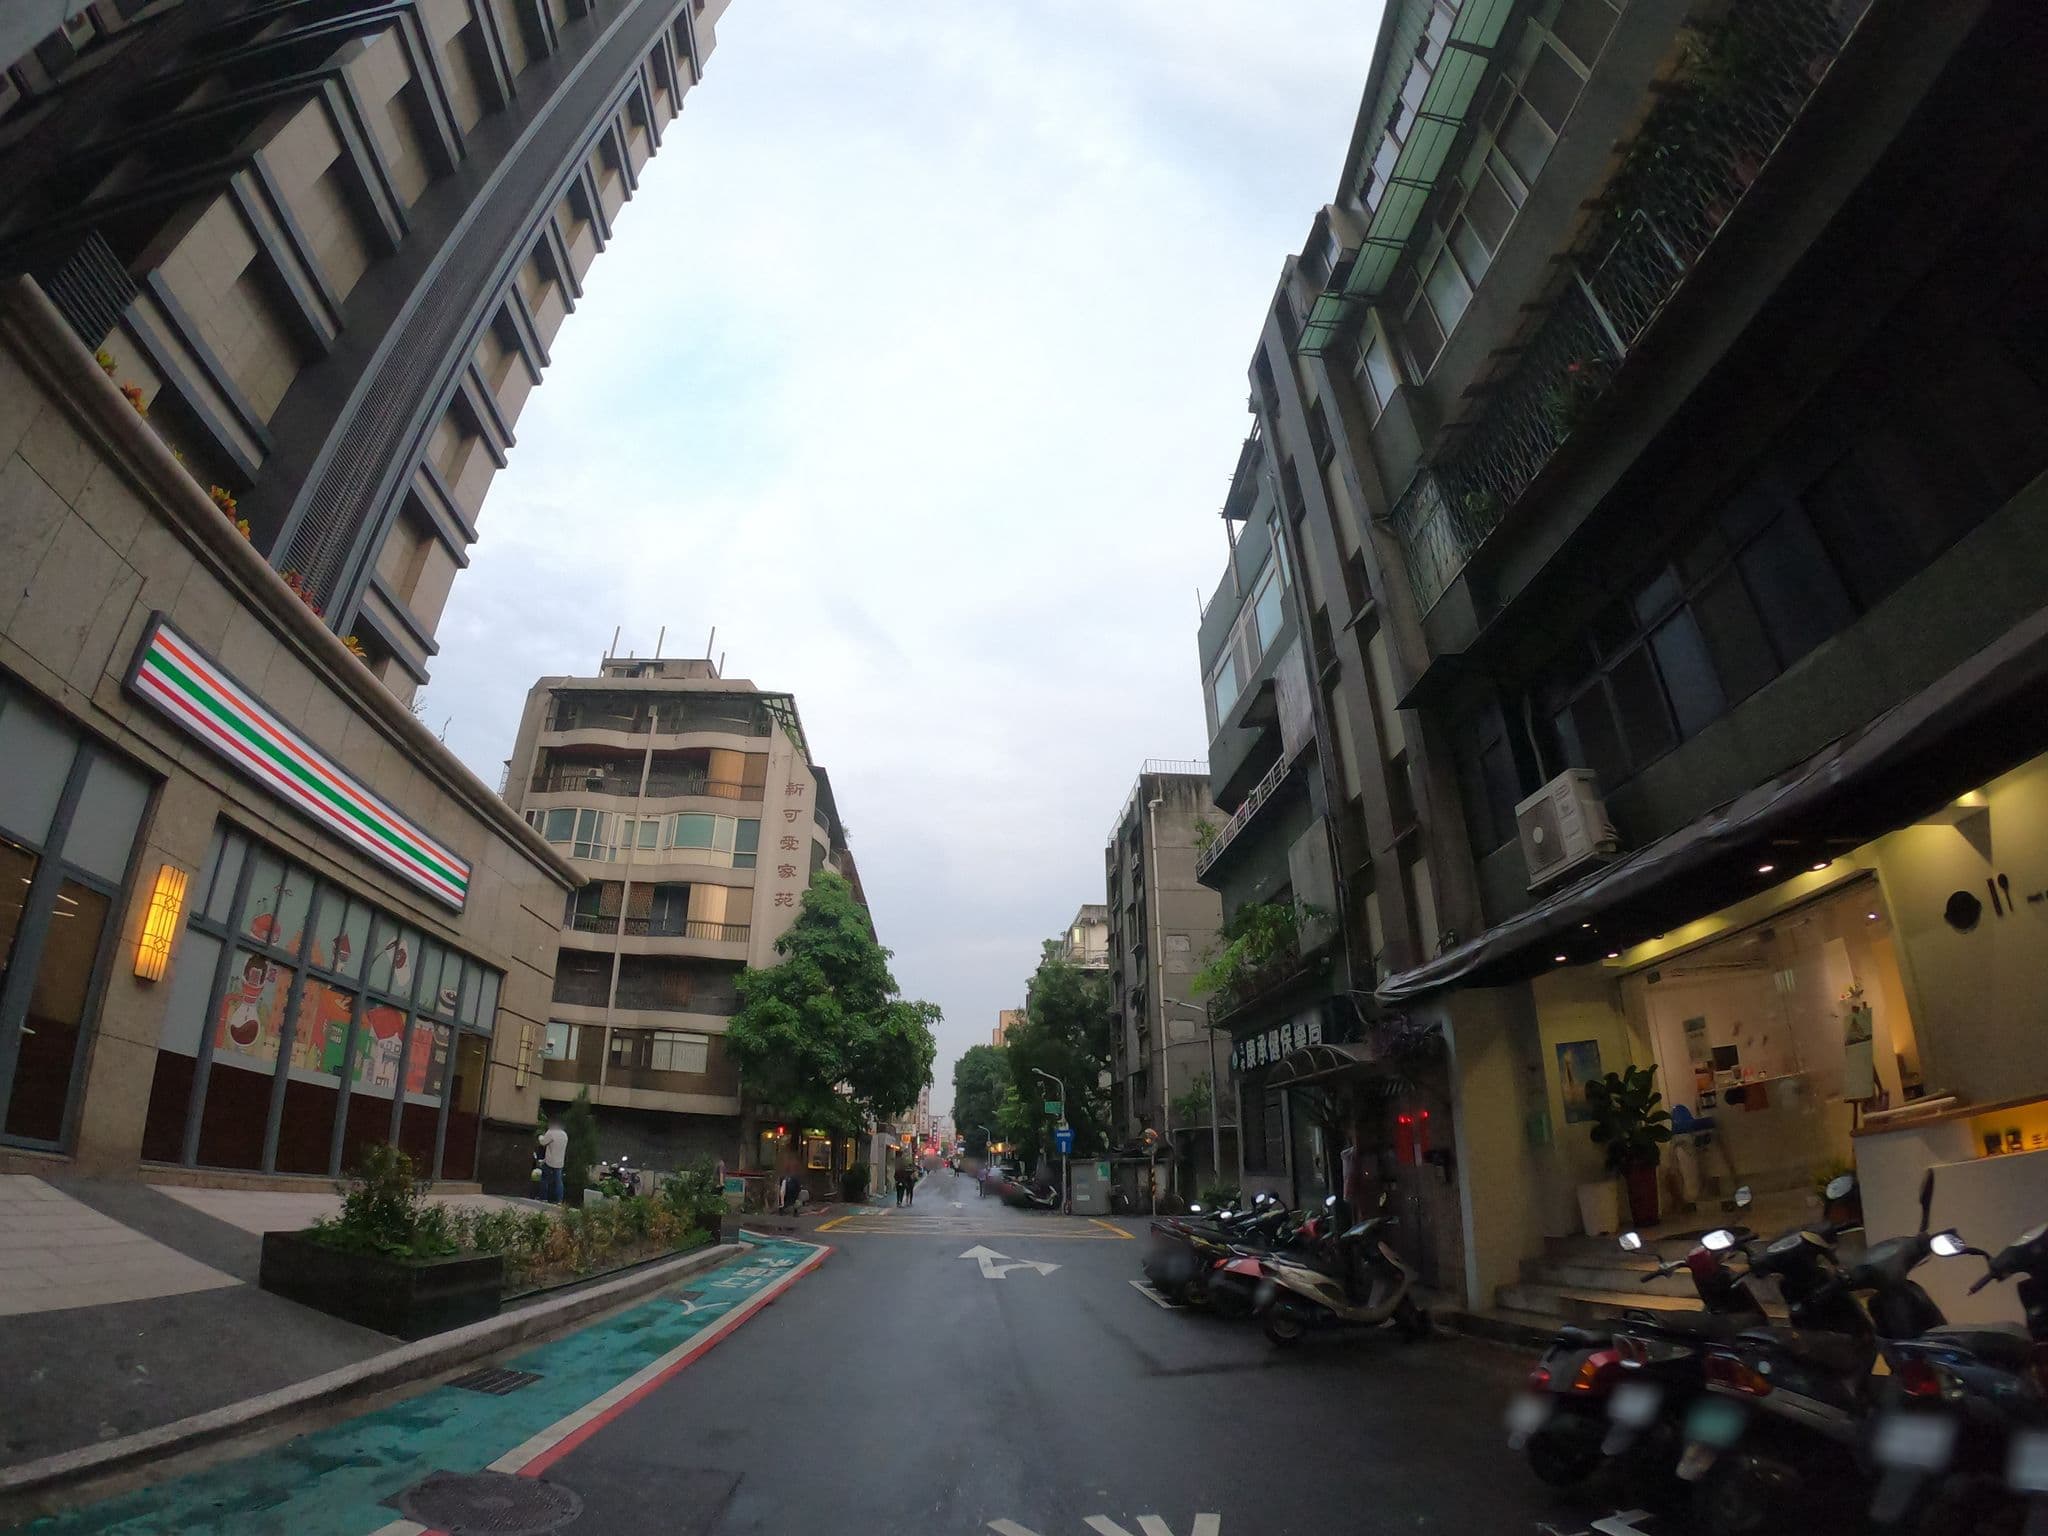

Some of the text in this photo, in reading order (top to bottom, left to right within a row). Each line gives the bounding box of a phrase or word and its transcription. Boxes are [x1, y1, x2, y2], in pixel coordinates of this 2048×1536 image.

[774, 782, 805, 908] 新可愛家苑
